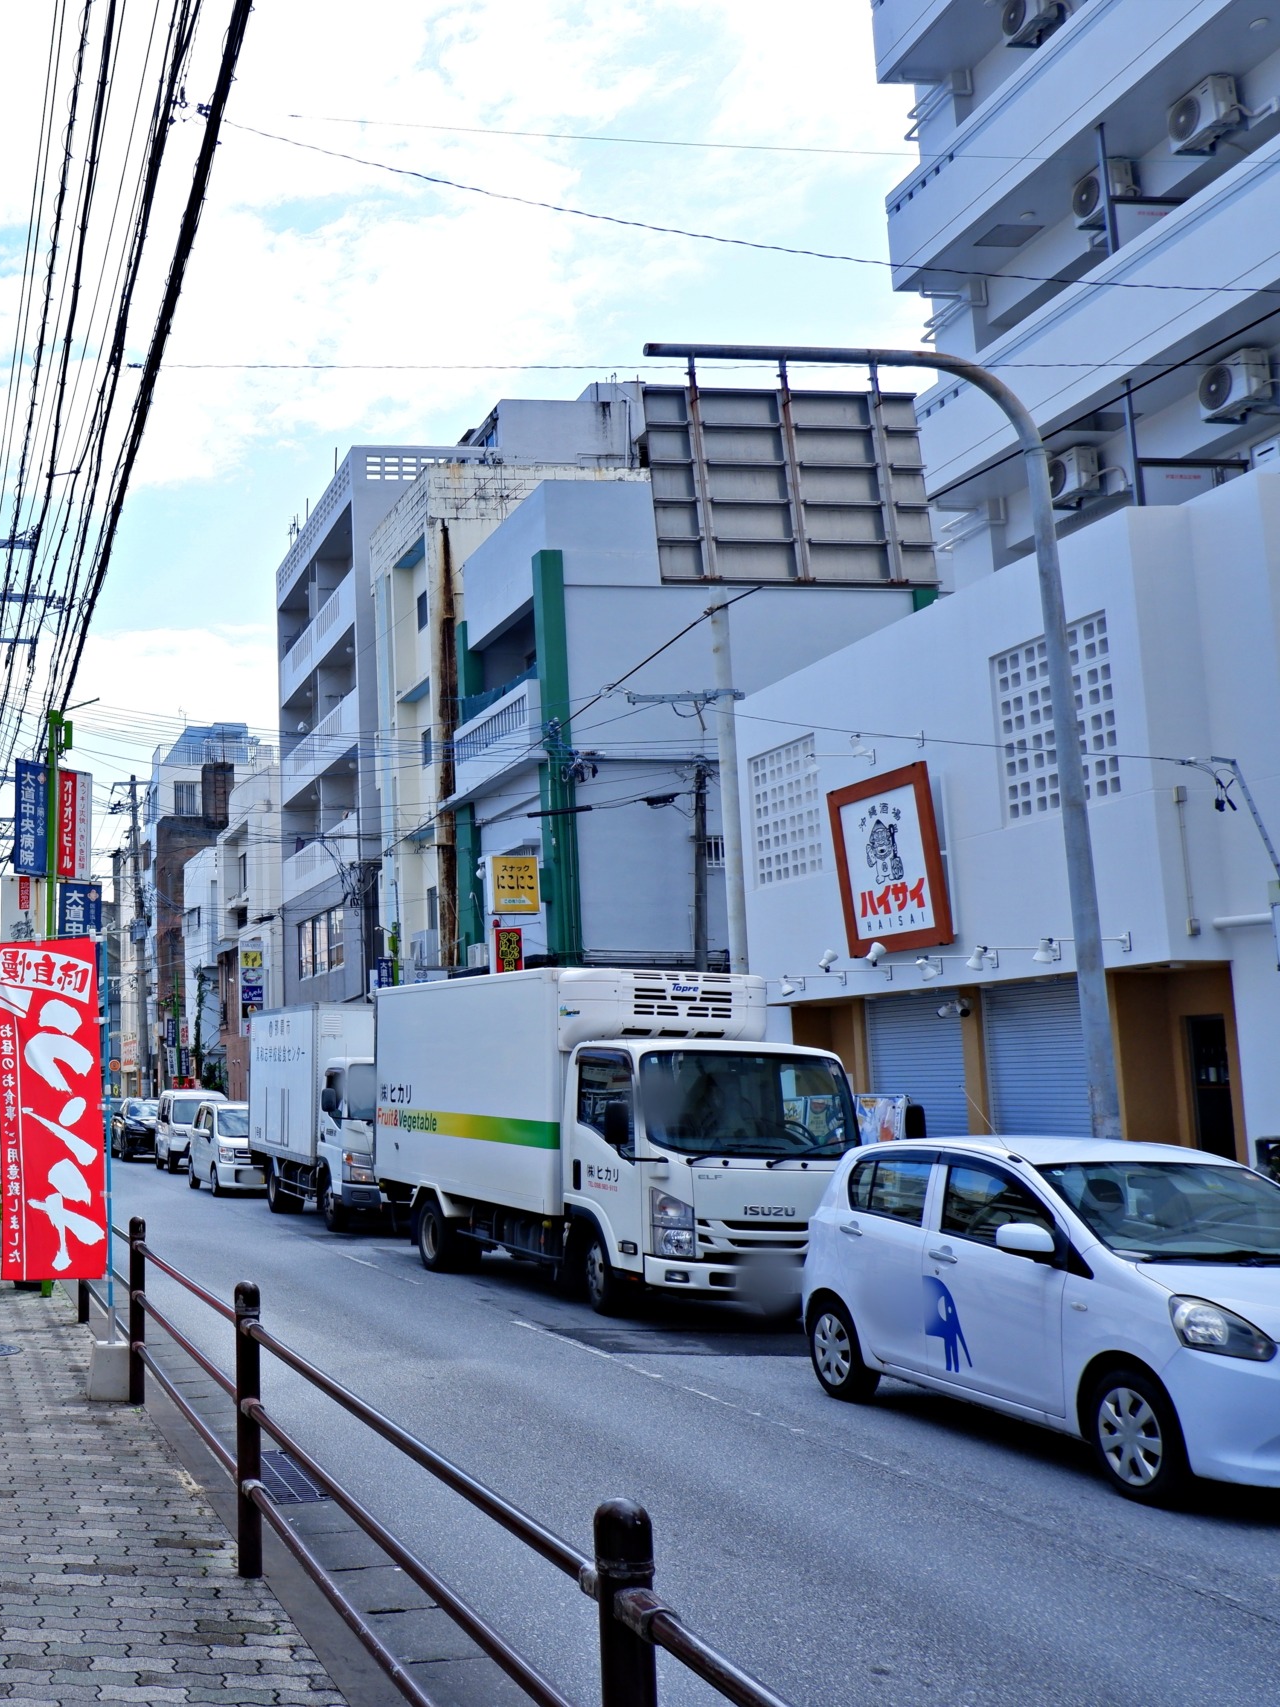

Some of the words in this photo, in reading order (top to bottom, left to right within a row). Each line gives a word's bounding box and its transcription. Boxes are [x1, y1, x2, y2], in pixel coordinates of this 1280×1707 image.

[19, 771, 36, 867] 大道中央病院
[62, 780, 73, 869] オリオンビール
[859, 803, 901, 832] 沖縄酒場
[497, 875, 535, 890] にこにこ
[860, 877, 926, 918] ハイサイ
[867, 911, 925, 932] HAISAI
[671, 983, 699, 993] Topre
[377, 1108, 438, 1132] Fruit&Vegetable
[743, 1205, 796, 1217] ISUZU
